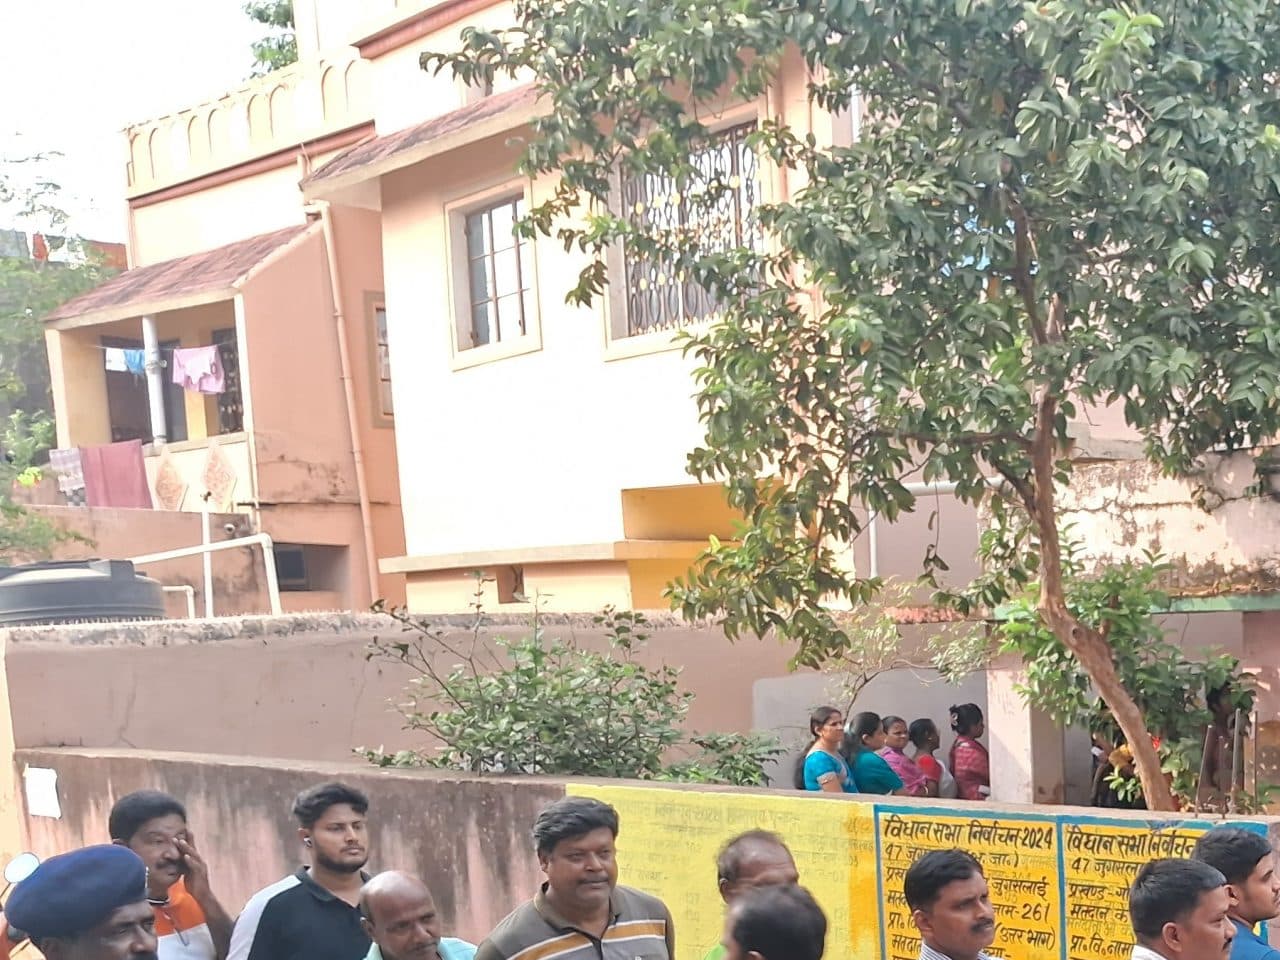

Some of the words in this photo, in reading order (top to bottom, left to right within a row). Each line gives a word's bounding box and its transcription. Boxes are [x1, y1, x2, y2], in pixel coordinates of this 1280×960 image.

[884, 815, 931, 839] विधान
[933, 823, 961, 843] सभा
[1067, 826, 1114, 854] विधान
[1117, 834, 1147, 858] सभा
[1071, 857, 1089, 874] 47
